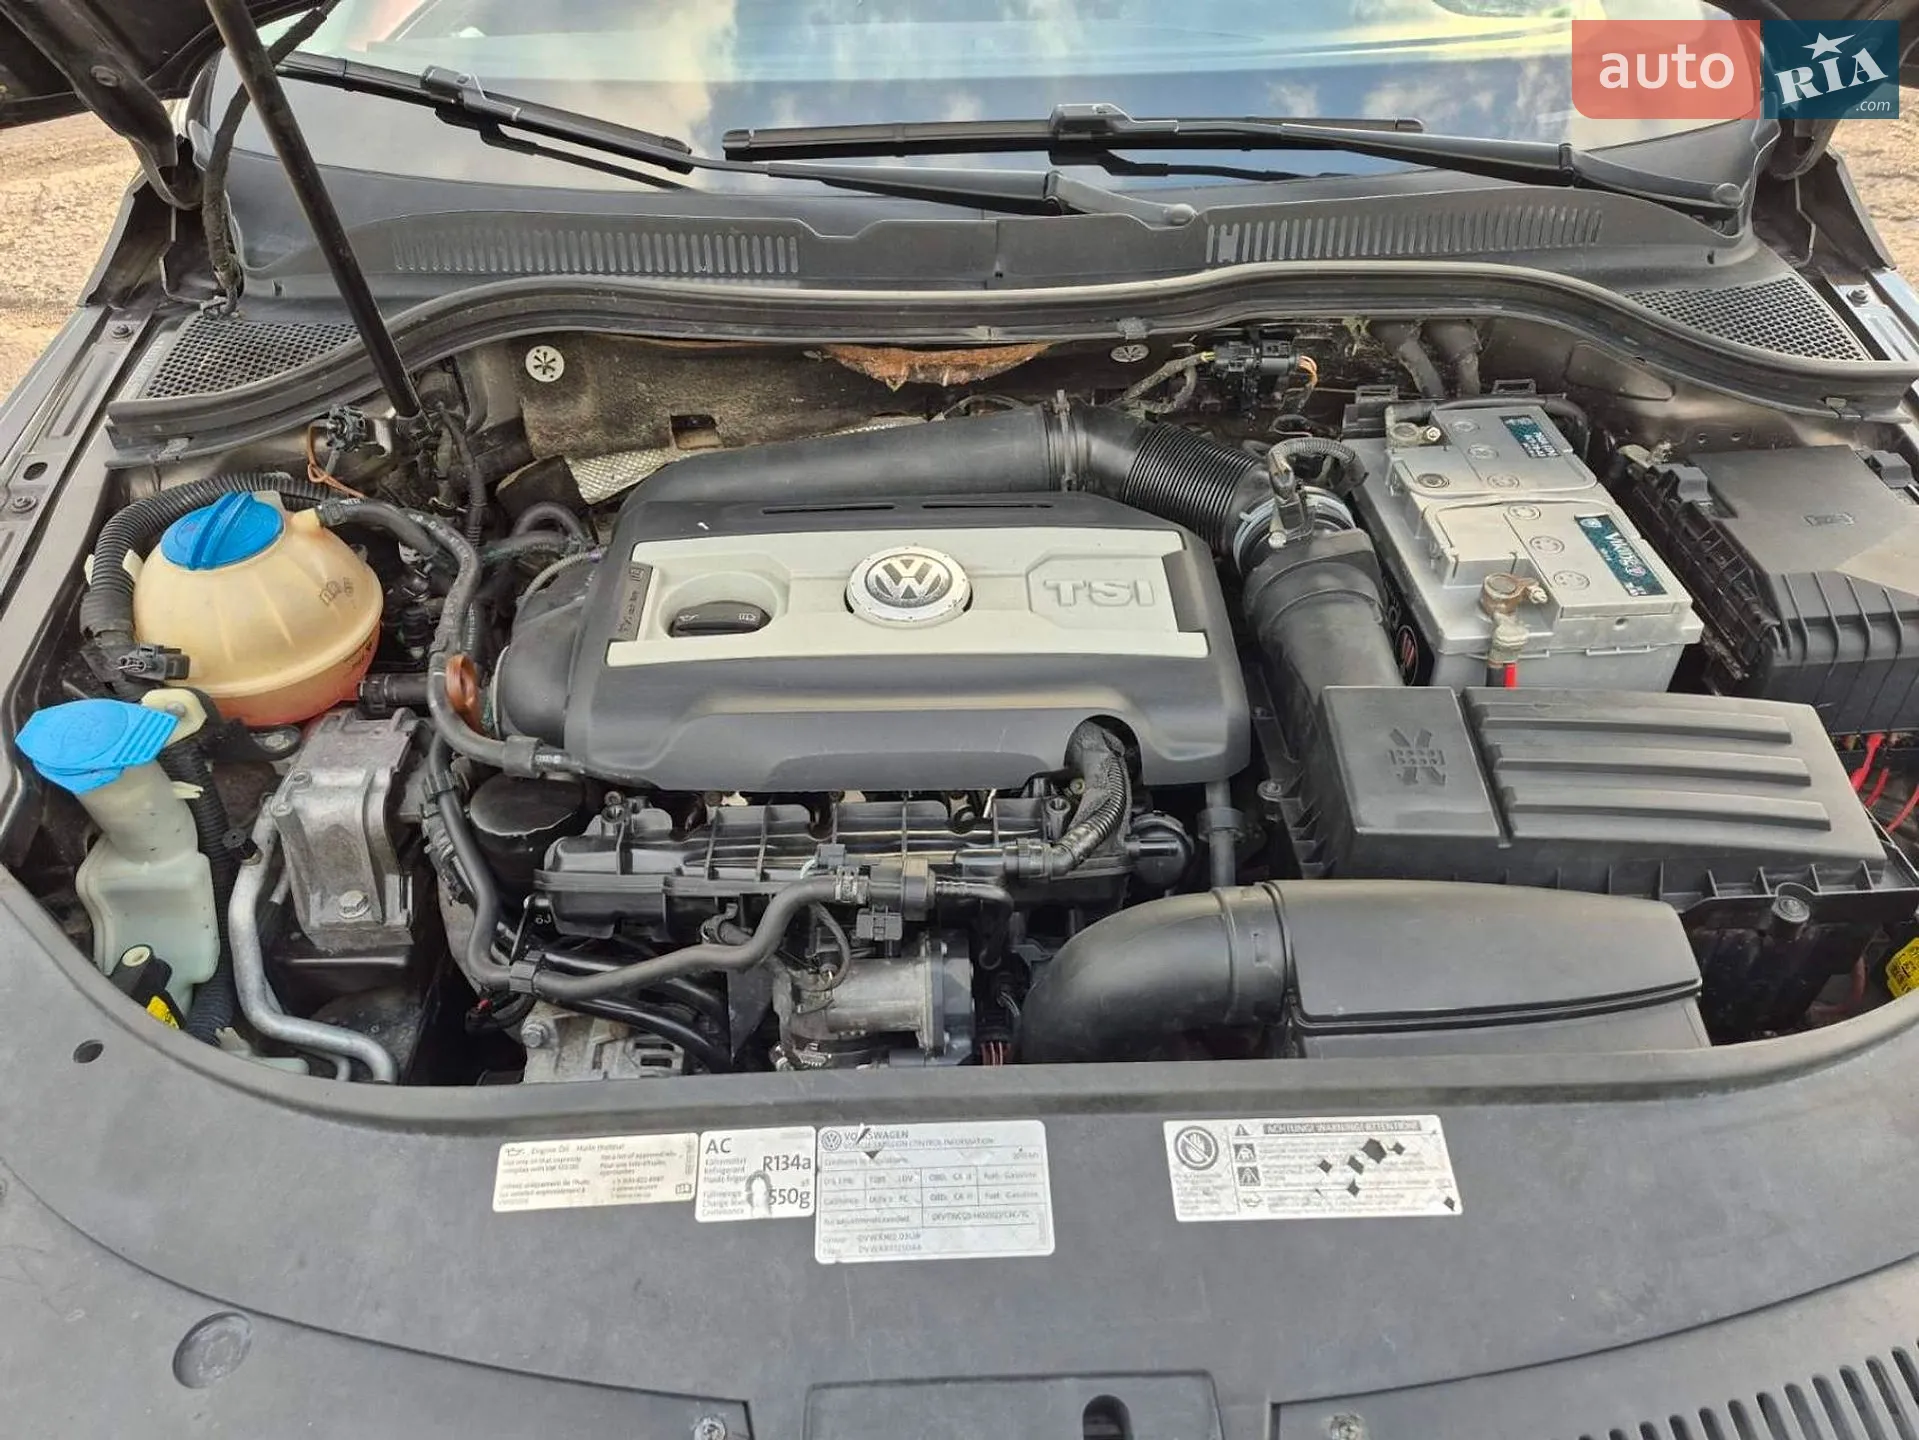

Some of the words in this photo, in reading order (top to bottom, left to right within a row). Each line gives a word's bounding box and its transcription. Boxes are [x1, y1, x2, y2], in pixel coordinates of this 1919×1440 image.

[1043, 579, 1155, 607] TSI
[705, 1137, 732, 1155] AC
[762, 1153, 811, 1171] R134a
[768, 1187, 811, 1209] 550g
